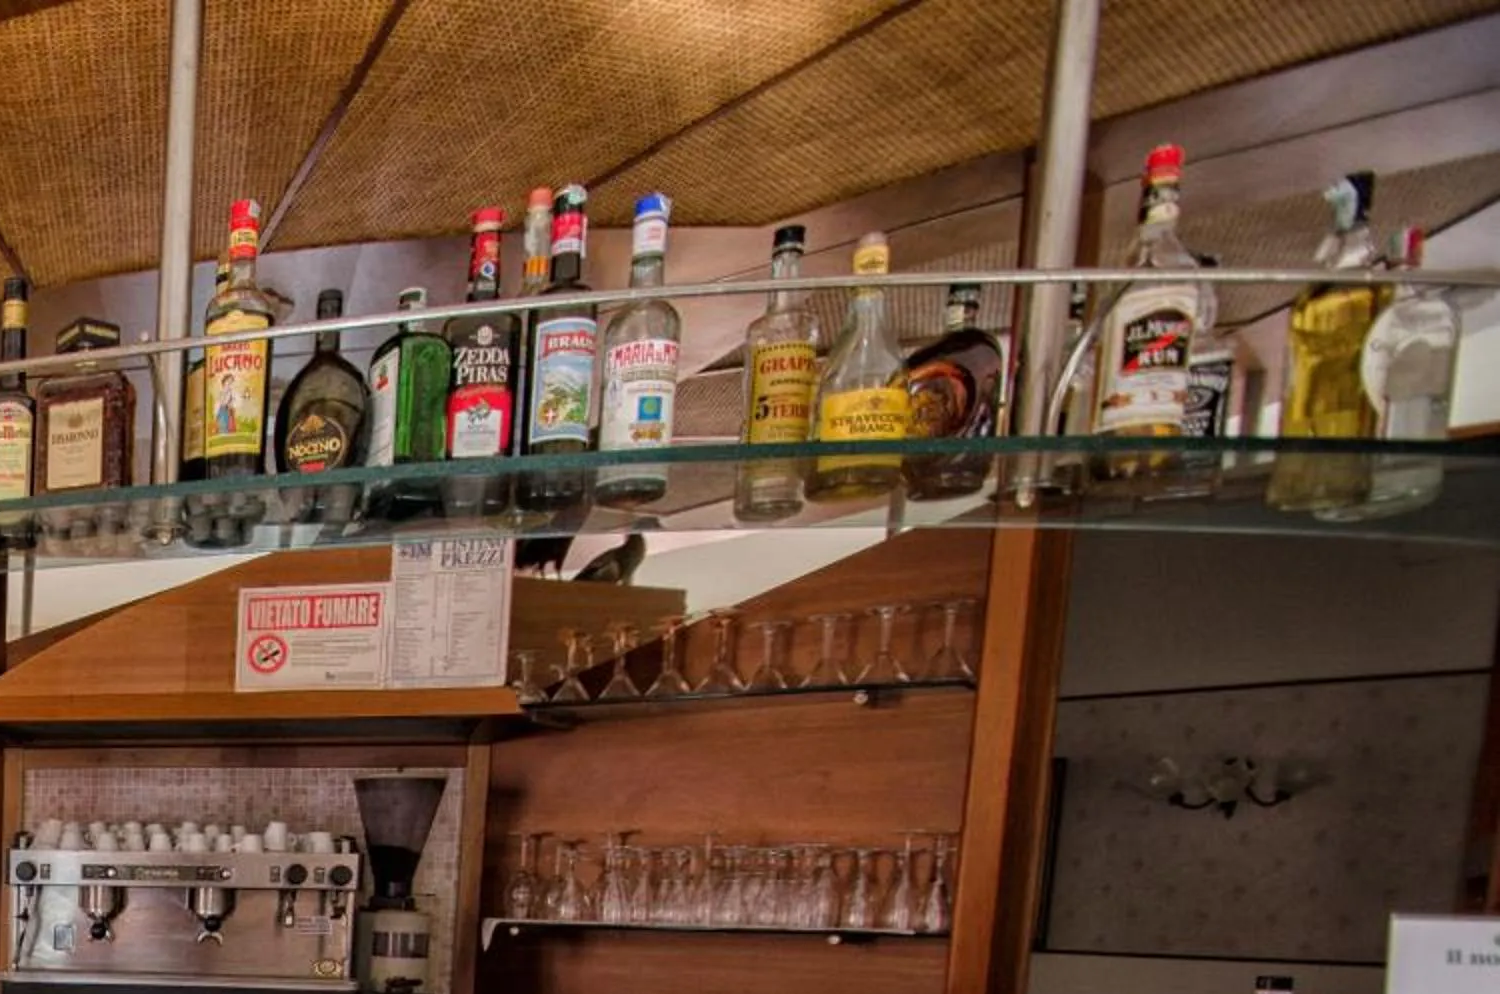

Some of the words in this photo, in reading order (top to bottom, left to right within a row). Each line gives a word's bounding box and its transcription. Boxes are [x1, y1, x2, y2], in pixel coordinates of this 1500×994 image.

[210, 353, 262, 377] LUCANO
[453, 347, 510, 367] ZEDDA
[456, 366, 508, 385] PIRAS
[251, 600, 311, 628] VIETATO
[313, 596, 378, 627] FUMARE
